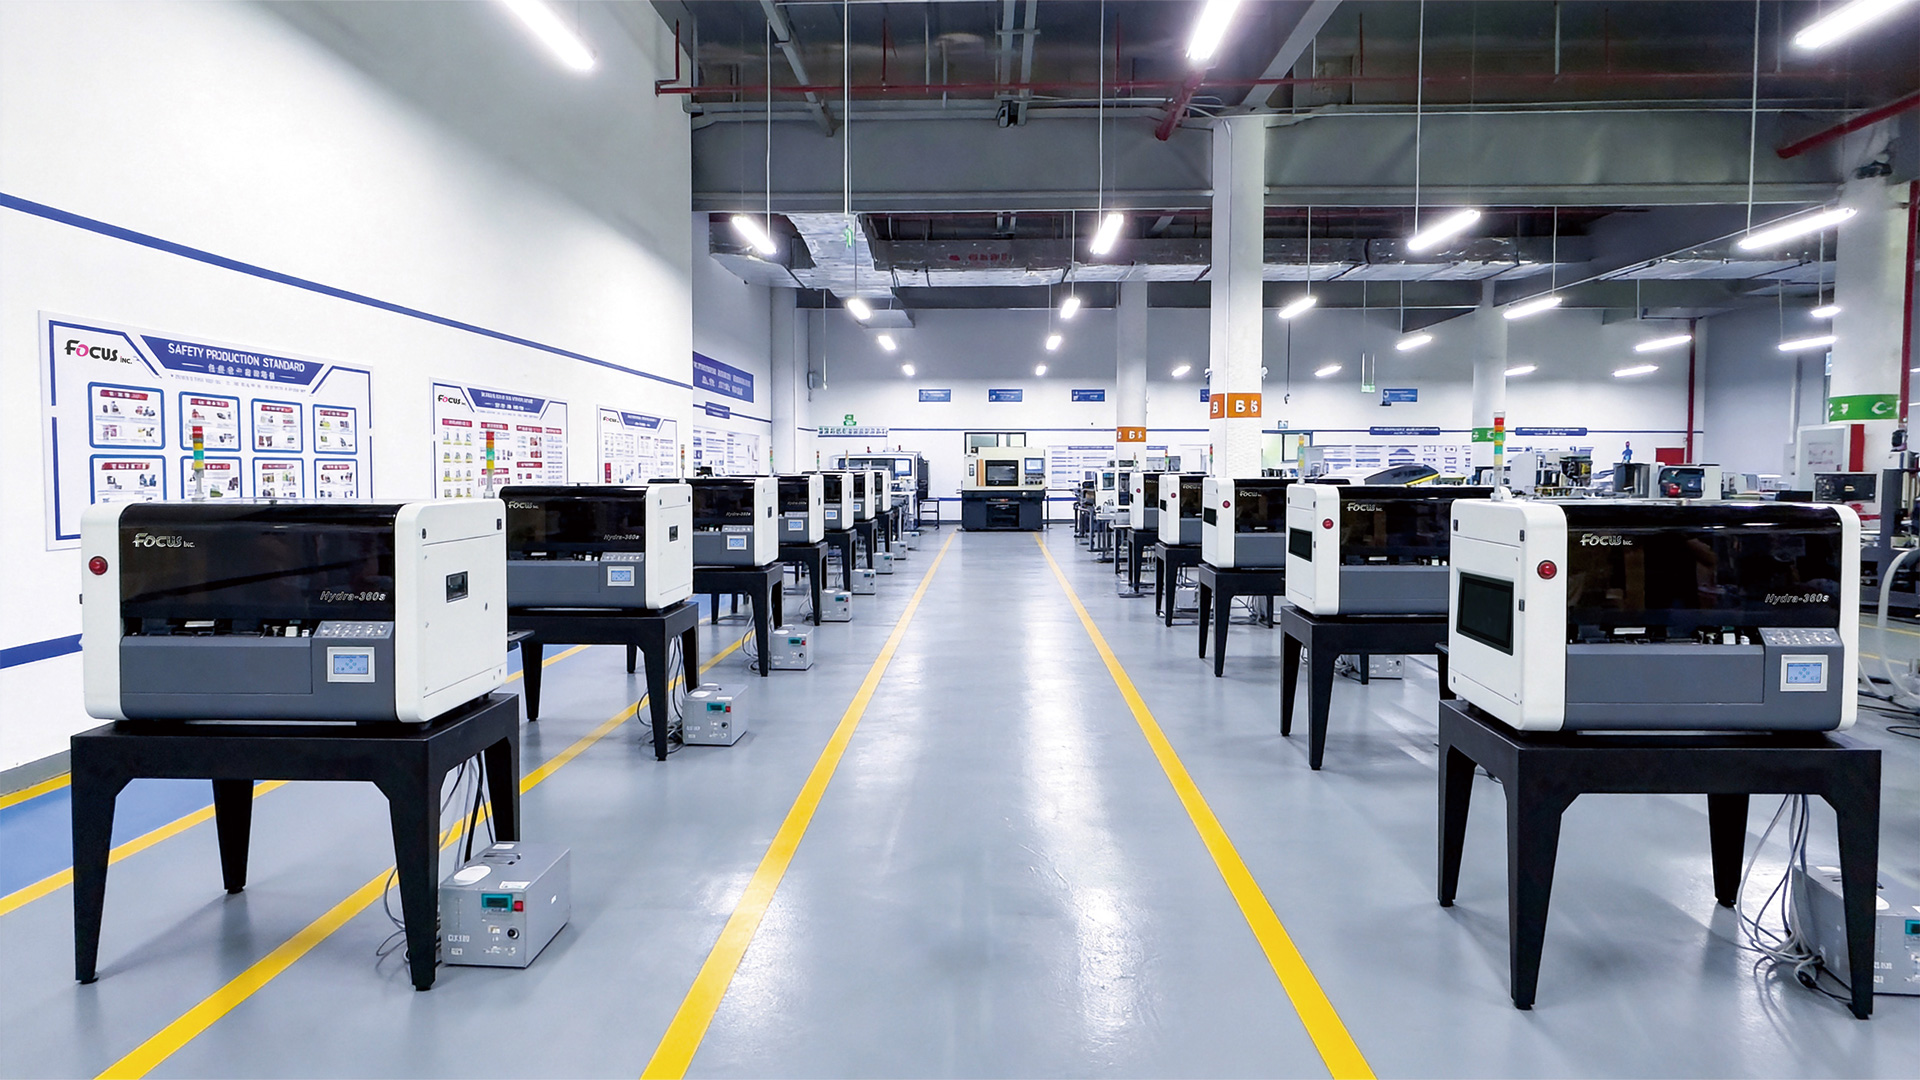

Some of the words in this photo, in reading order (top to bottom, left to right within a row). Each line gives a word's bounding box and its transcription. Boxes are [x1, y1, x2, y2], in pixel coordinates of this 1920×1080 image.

[64, 339, 118, 361] FOCUS
[168, 343, 204, 358] SAFETY
[206, 349, 260, 366] PRODUCTION
[263, 357, 306, 373] STANDARD
[438, 395, 461, 405] FOCUS
[132, 532, 183, 548] FOCUS
[1580, 533, 1622, 546] FOCUS
[320, 591, 386, 603] Hydra-360s
[1765, 593, 1830, 605] Hydra-360s
